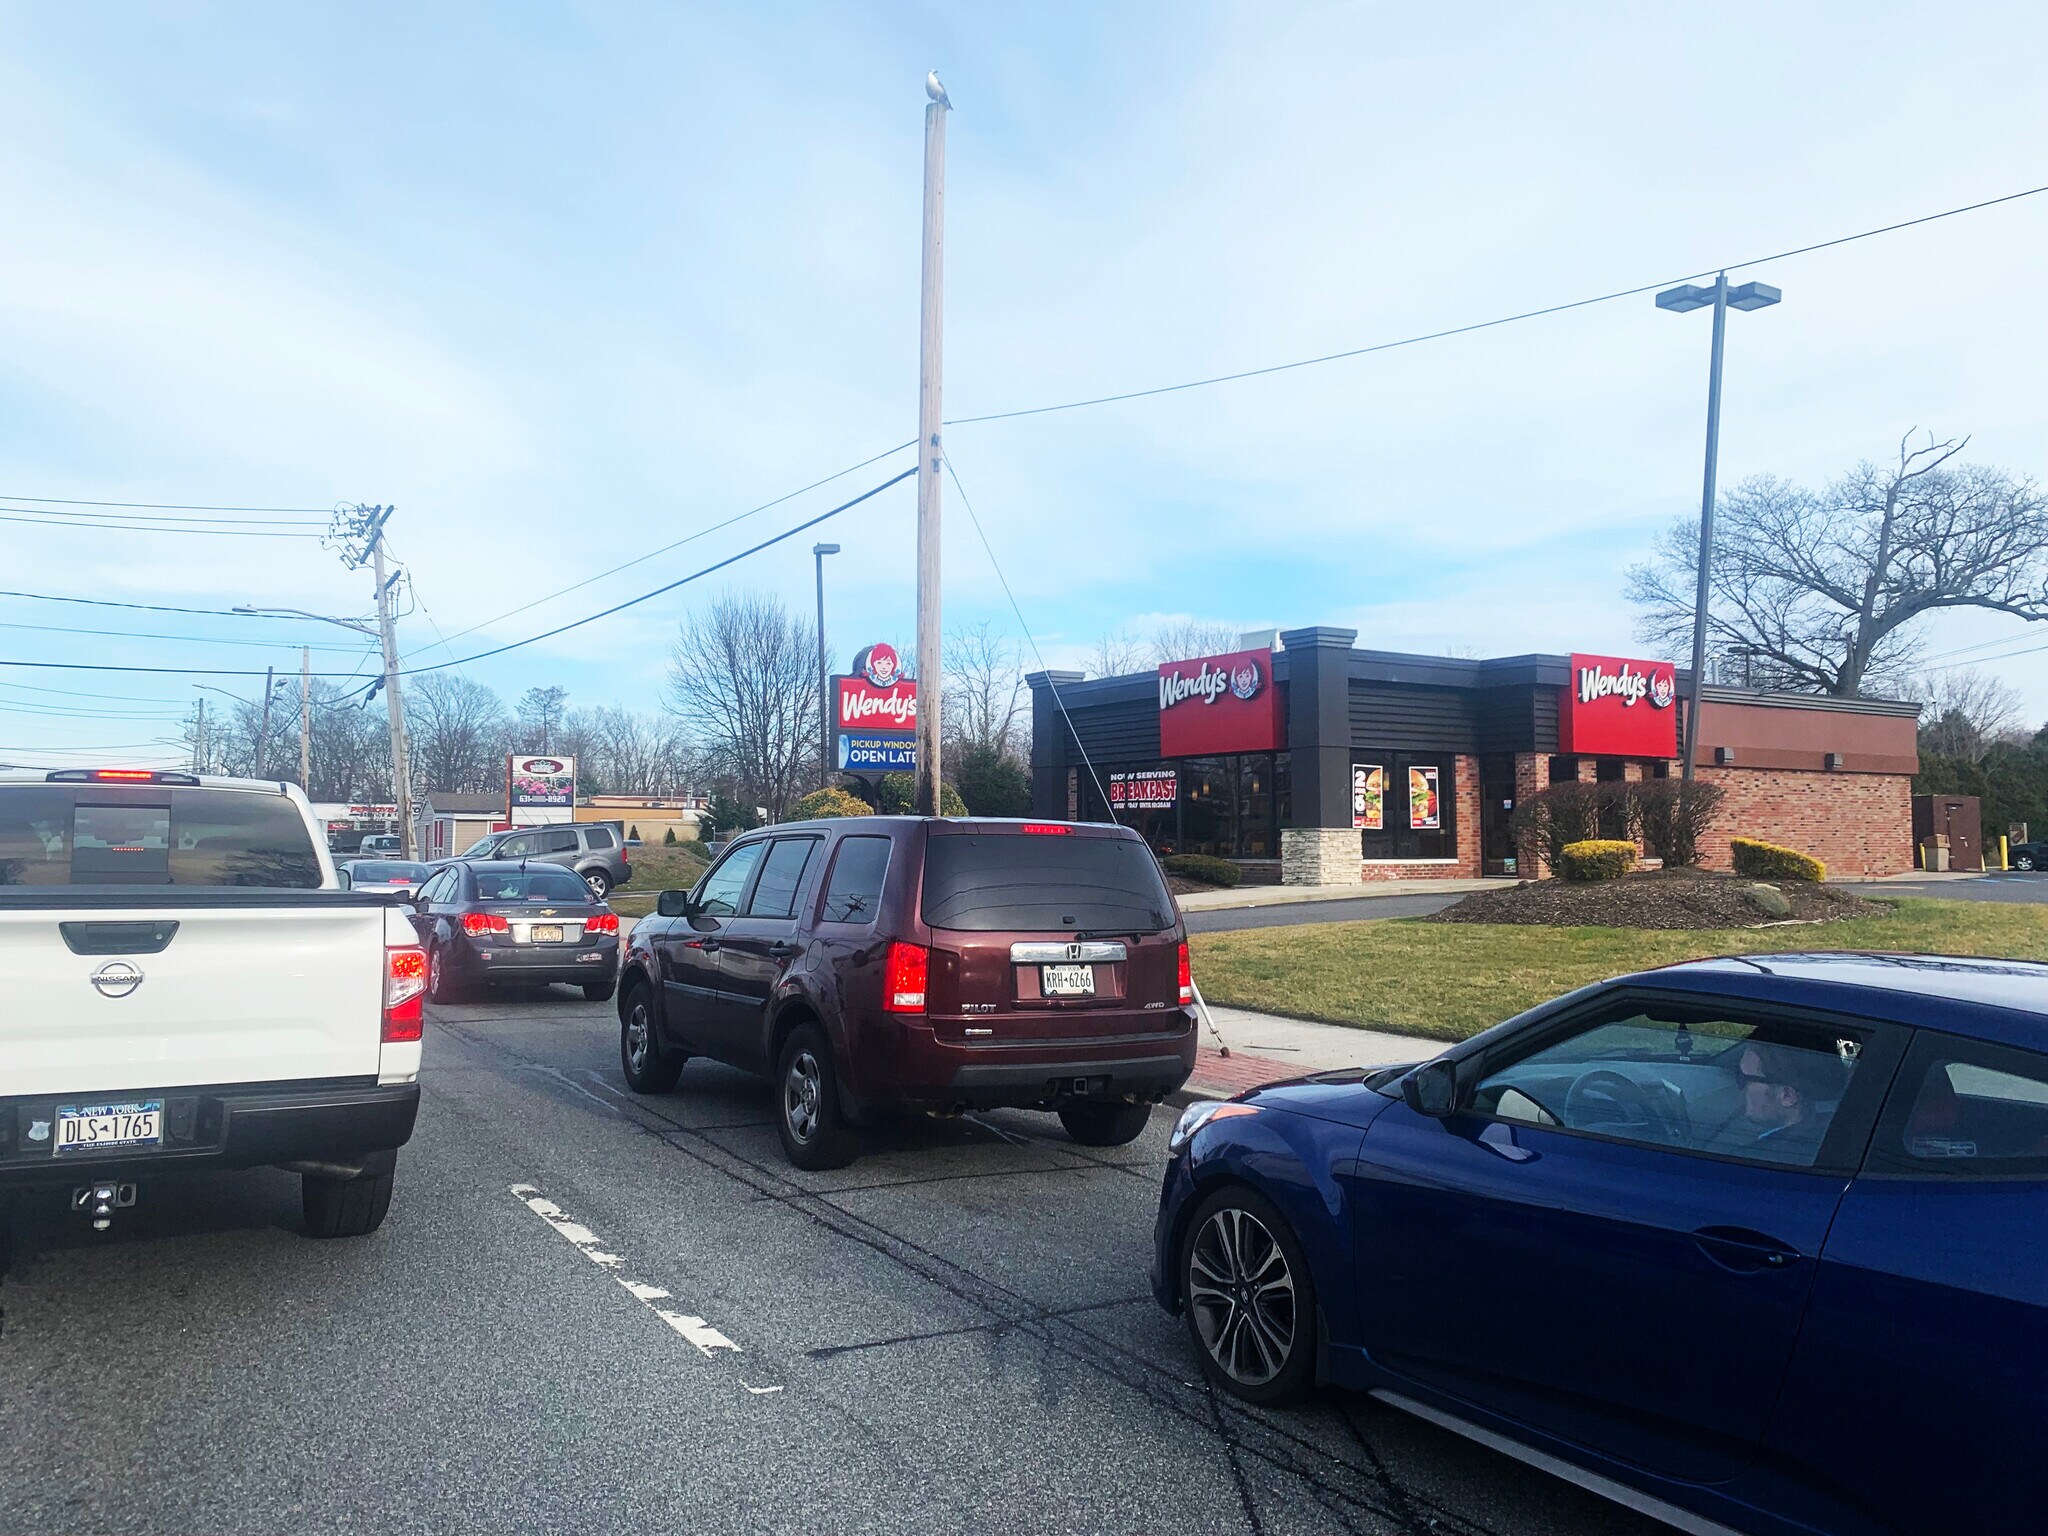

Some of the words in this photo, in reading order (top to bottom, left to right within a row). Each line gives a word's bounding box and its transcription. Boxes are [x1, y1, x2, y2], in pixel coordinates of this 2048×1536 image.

[1159, 662, 1227, 709] Wendy's
[1581, 663, 1646, 706] Wendy's
[843, 687, 917, 724] Wendy's
[851, 740, 881, 748] PICKUP
[850, 750, 887, 763] OPEN
[1136, 771, 1176, 779] SERVING
[1355, 770, 1366, 787] 2
[1111, 780, 1176, 801] BREAKFAST
[97, 975, 138, 983] NISSAN
[961, 1003, 997, 1013] PILOT
[1144, 1001, 1165, 1009] 4WD
[83, 1106, 108, 1117] NEW
[111, 1103, 138, 1115] YORK
